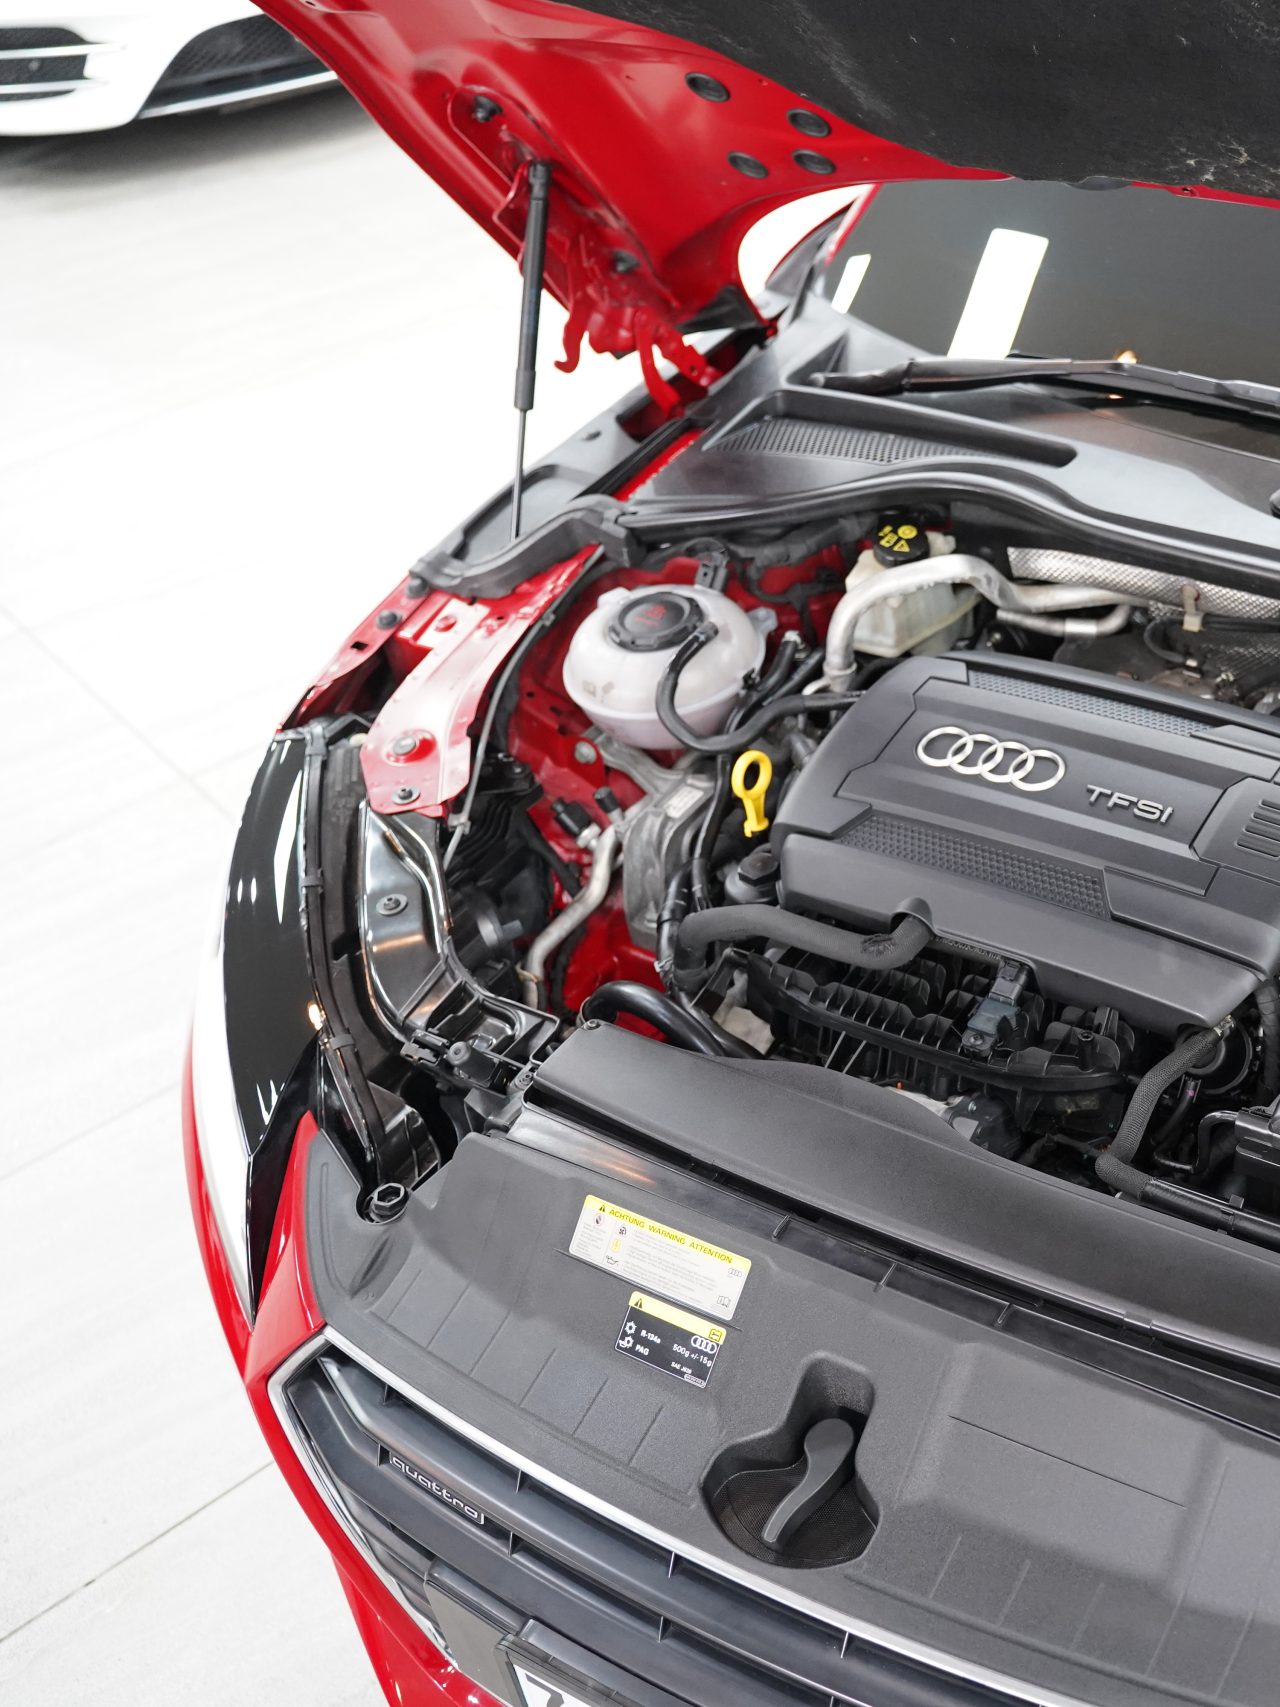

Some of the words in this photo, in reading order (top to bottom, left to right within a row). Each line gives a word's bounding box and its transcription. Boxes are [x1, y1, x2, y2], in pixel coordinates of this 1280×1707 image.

[1086, 784, 1174, 823] TFSI
[608, 1208, 645, 1229] ACHTUNG
[648, 1225, 686, 1245] WARNING
[689, 1237, 734, 1265] ATTENTION
[635, 1344, 650, 1356] PAG
[640, 1329, 662, 1344] R-134a
[672, 1343, 690, 1358] 500g
[392, 1456, 479, 1519] quattro
